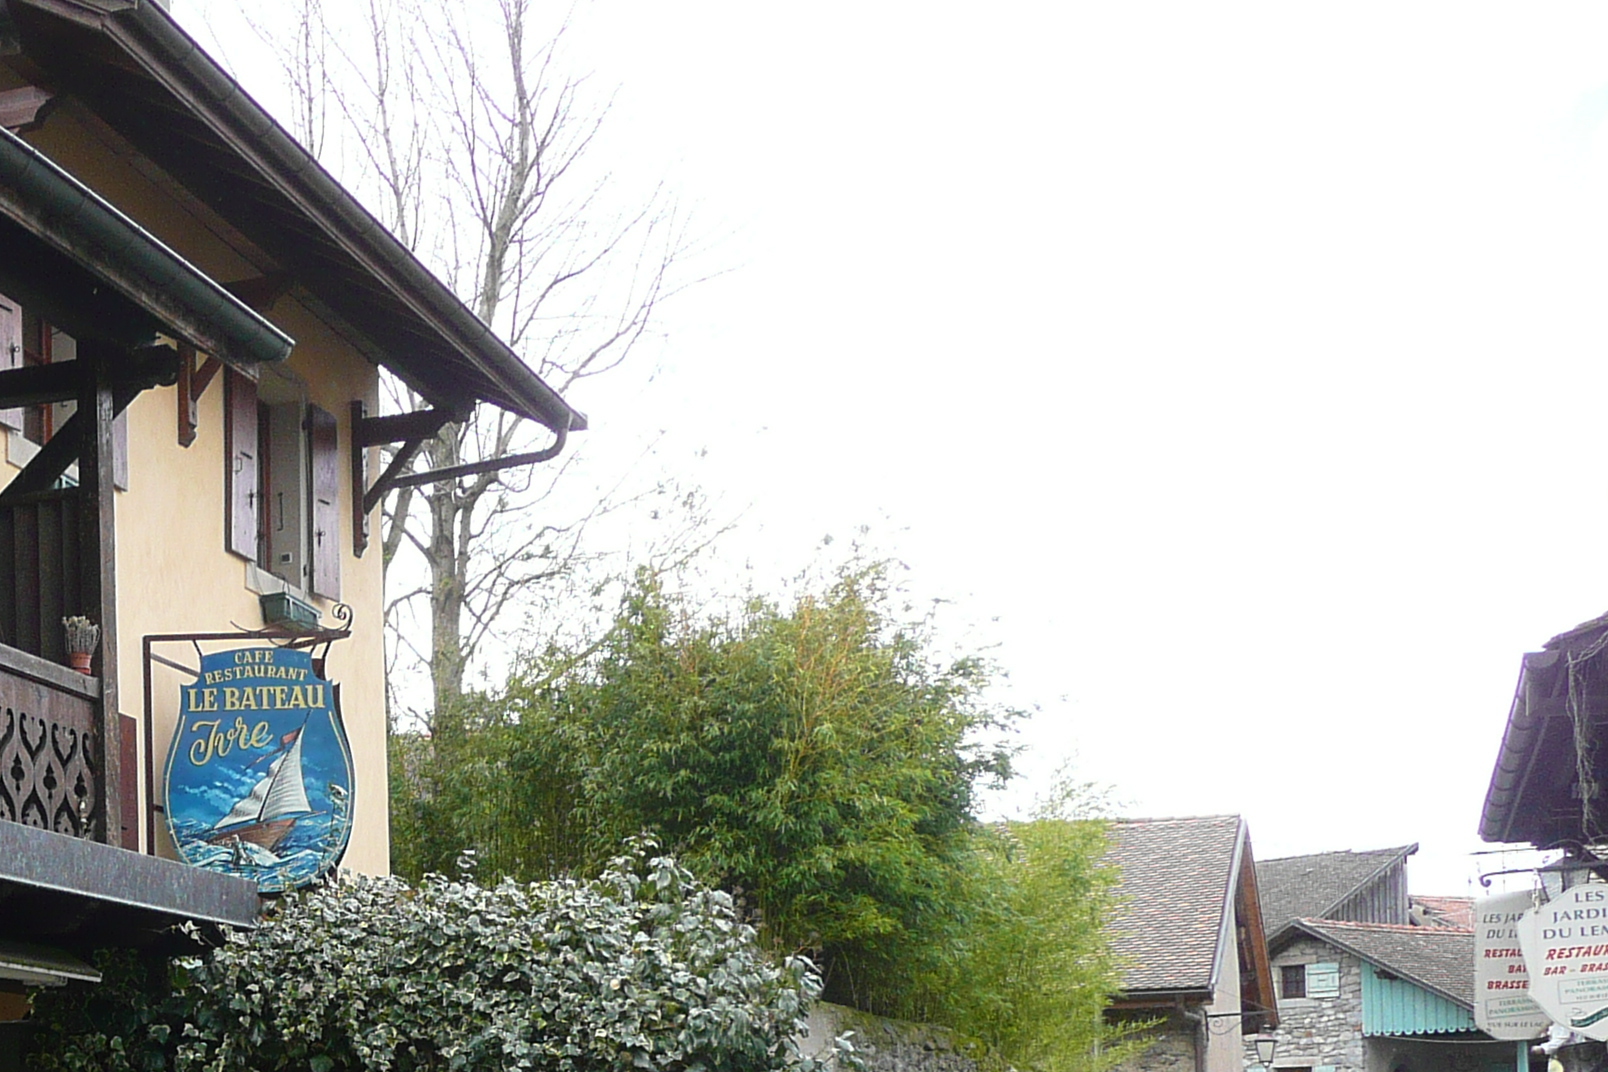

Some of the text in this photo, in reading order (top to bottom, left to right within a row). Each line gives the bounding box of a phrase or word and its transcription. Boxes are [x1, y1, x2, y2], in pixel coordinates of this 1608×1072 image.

[234, 650, 274, 664] CAFE
[204, 664, 308, 685] RESTAURANT
[187, 684, 326, 712] LE BATEAU
[189, 715, 274, 766] Ivre
[1574, 890, 1605, 904] LES
[1482, 913, 1501, 924] LES
[1553, 907, 1608, 924] JARDI
[1486, 929, 1505, 939] DU
[1542, 927, 1572, 940] DU
[1543, 965, 1567, 976] BAR
[1580, 962, 1608, 973] BRAS
[1486, 980, 1529, 990] BRASSE
